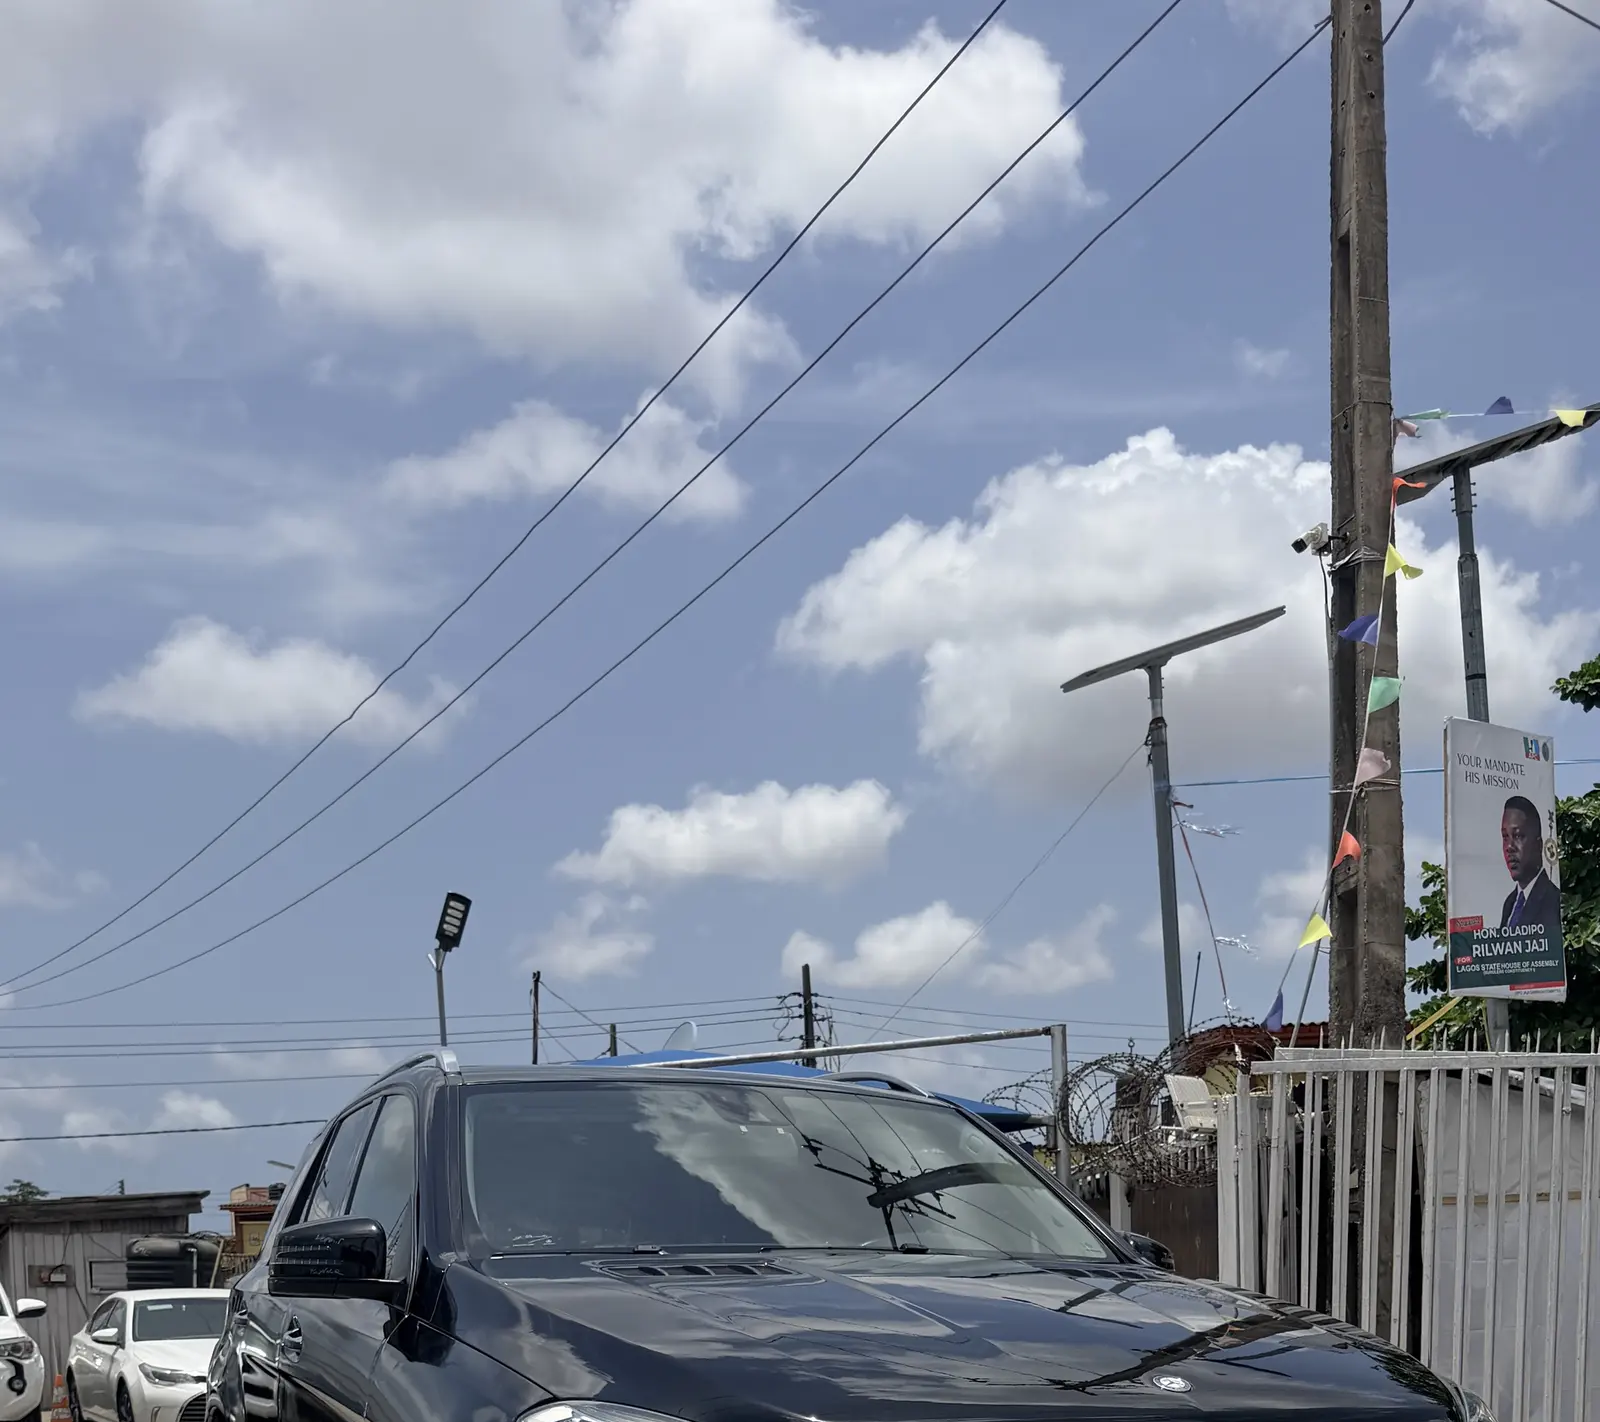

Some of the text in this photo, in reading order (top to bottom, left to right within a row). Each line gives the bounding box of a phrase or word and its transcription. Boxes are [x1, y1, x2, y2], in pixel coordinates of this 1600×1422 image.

[1457, 753, 1526, 776] YOUR MANDATE
[1465, 771, 1520, 790] HIS MISSION
[1473, 923, 1545, 940] HON. OLADIPO
[1472, 938, 1549, 958] RILWAN JAJI
[1456, 964, 1480, 973] LAGOS
[1481, 962, 1501, 971] STATE
[1530, 959, 1560, 968] ASSEMBLY
